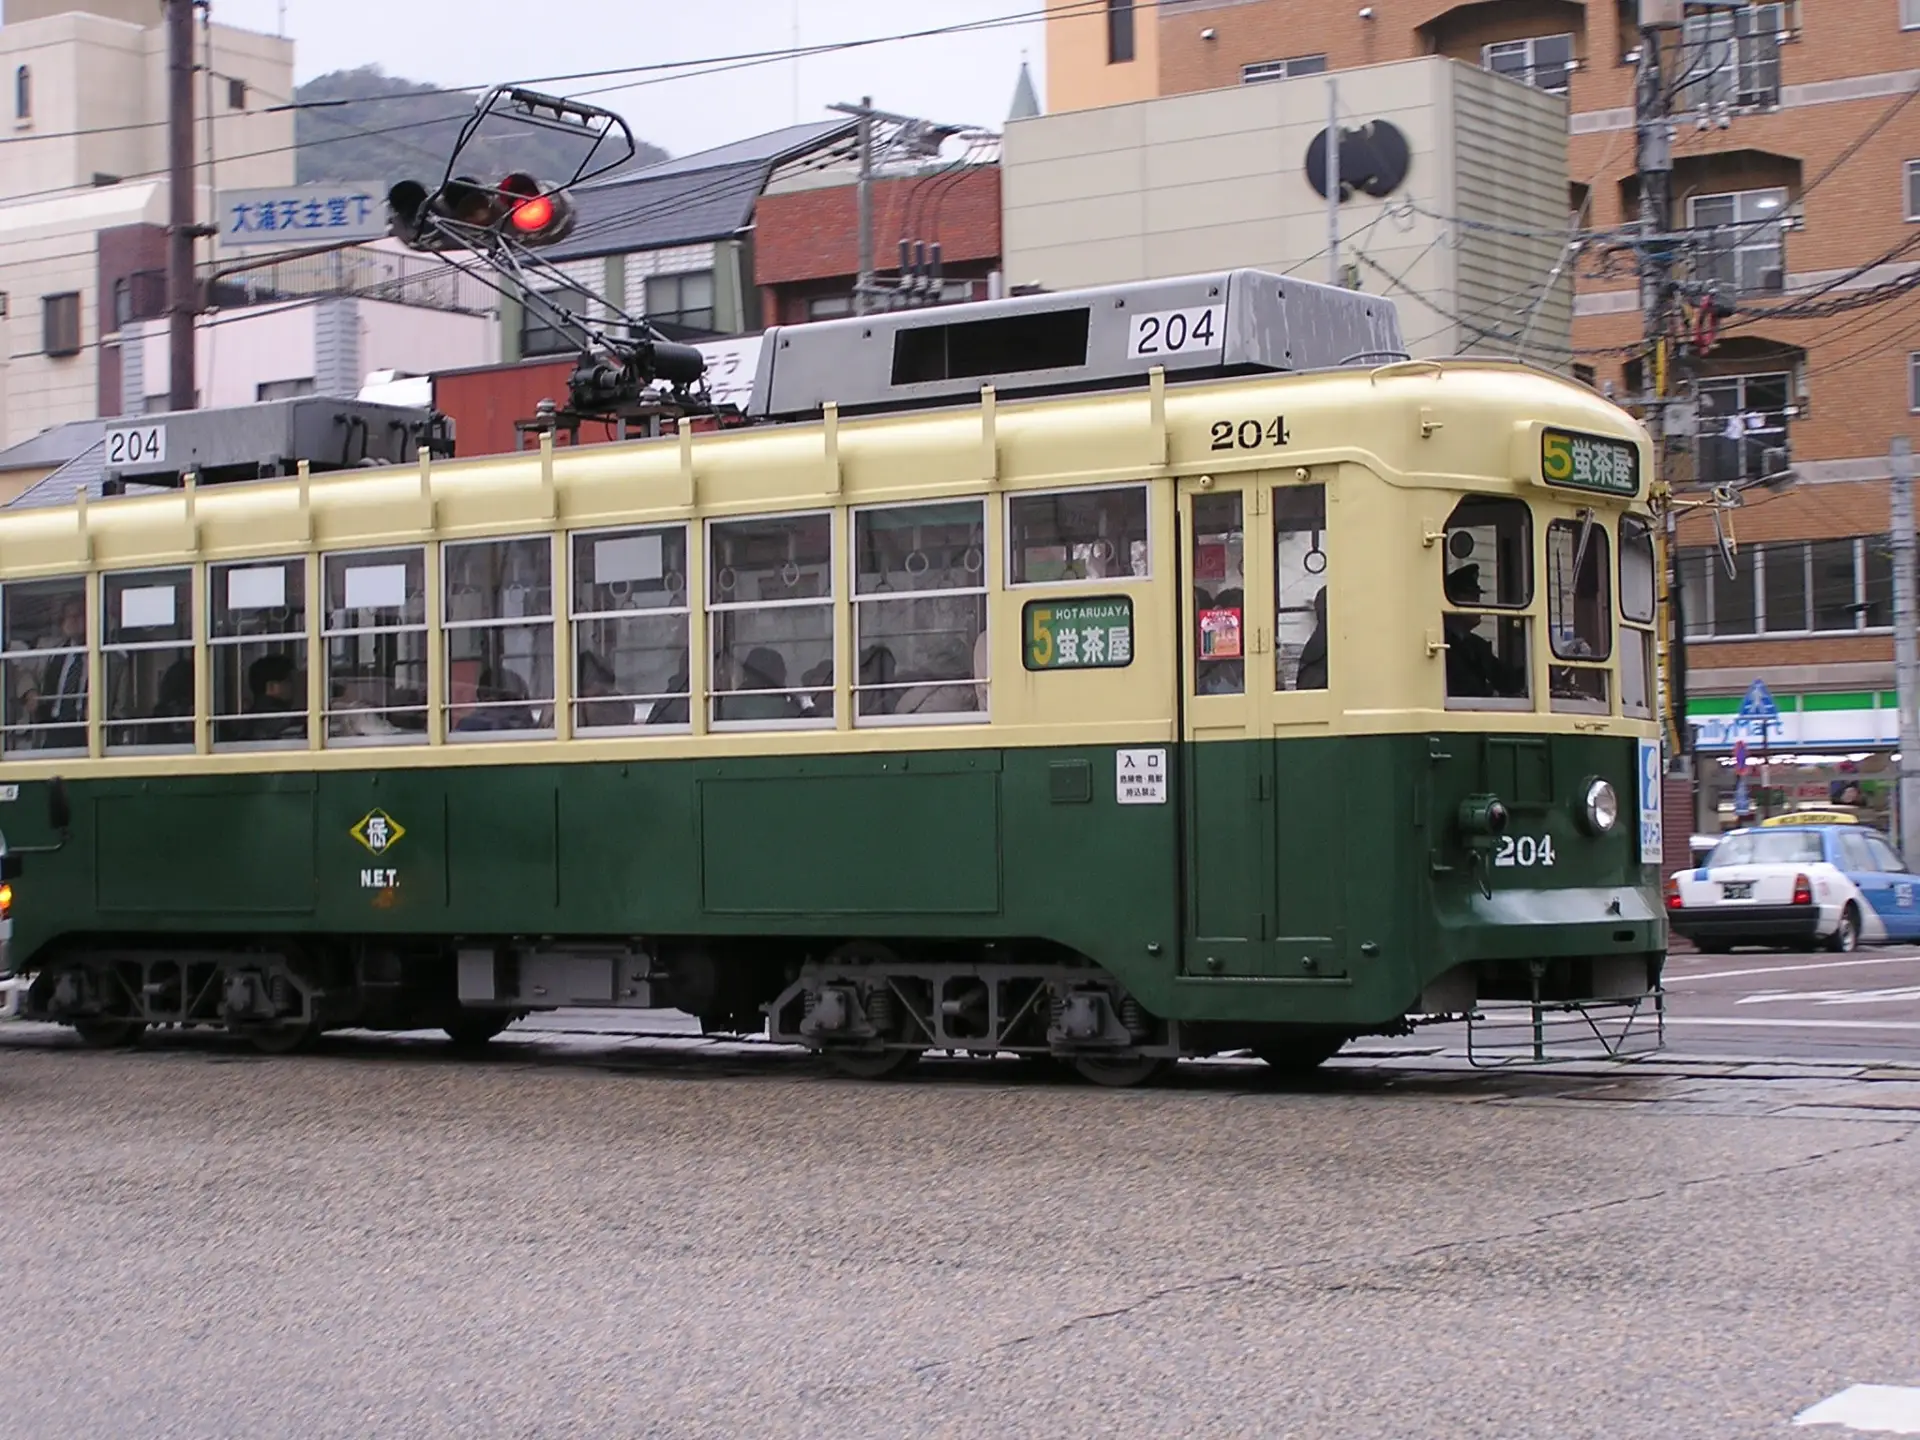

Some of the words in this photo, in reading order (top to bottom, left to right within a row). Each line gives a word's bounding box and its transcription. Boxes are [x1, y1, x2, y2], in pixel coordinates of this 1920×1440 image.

[1137, 309, 1214, 354] 204
[111, 428, 159, 462] 204
[1211, 415, 1290, 451] 204
[1543, 434, 1572, 479] 5
[1571, 439, 1634, 488] 蛍茶屋
[1056, 606, 1130, 620] HOTARUJAYA
[1033, 609, 1053, 665] 5
[1057, 626, 1130, 664] 蛍茶屋
[1495, 835, 1556, 866] 204
